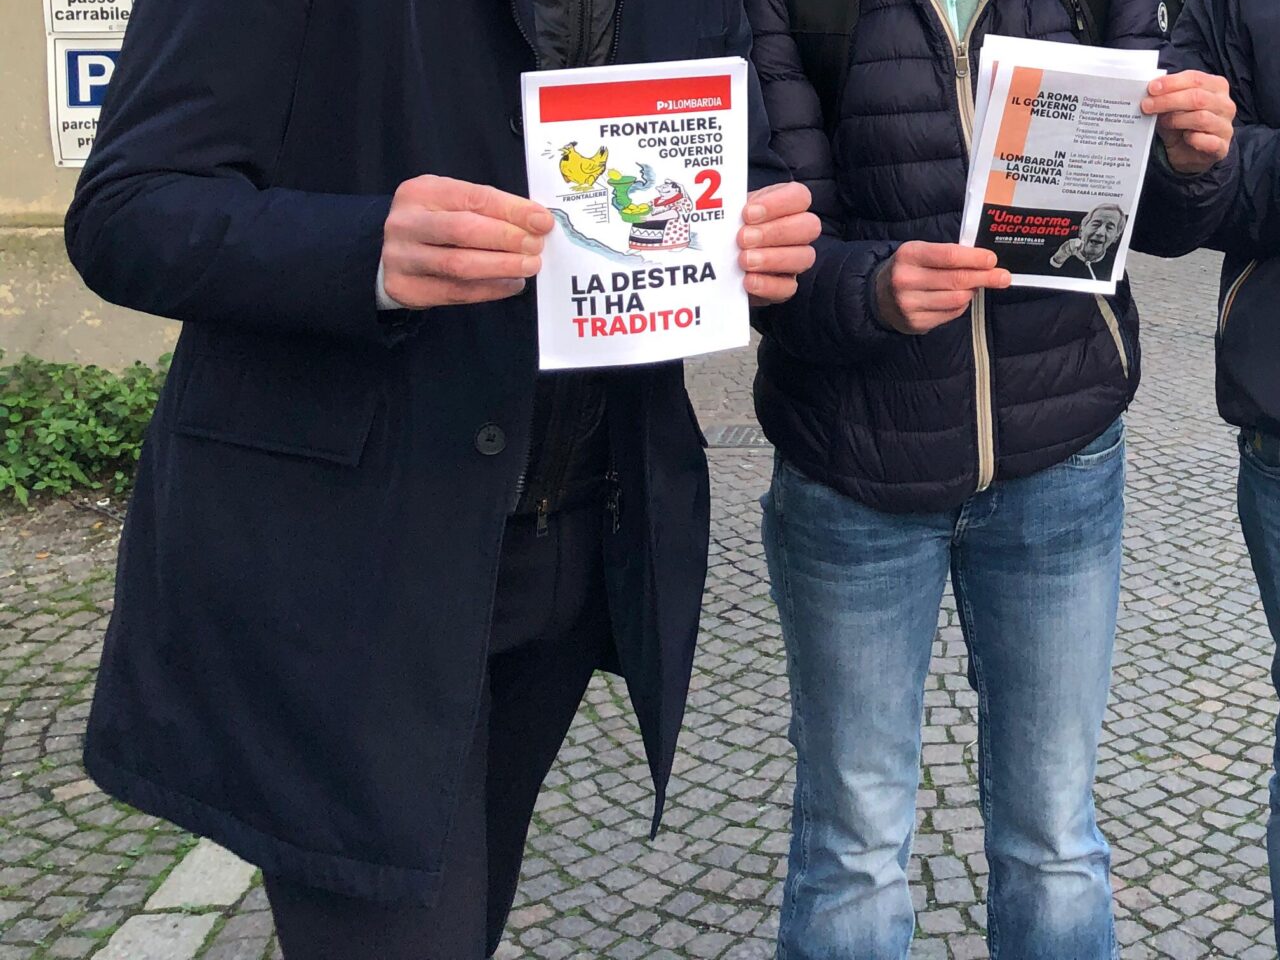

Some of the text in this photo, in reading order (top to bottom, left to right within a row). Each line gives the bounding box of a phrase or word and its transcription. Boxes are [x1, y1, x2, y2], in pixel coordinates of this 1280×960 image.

[55, 7, 130, 21] carrabile
[77, 55, 116, 102] P
[673, 97, 722, 110] LOMBARDIA
[1011, 96, 1077, 112] IL GOVERNO
[1037, 91, 1079, 104] A ROMA
[1030, 107, 1076, 121] MELONI:
[62, 118, 99, 132] parch
[600, 117, 722, 138] FRONTALIERE,
[637, 132, 723, 149] CON QUESTO
[659, 144, 723, 159] GOVERNO
[1054, 150, 1067, 160] IN
[684, 155, 724, 168] PAGHI
[1000, 152, 1065, 169] LOMBARDIA
[1006, 162, 1063, 177] LA GIUNTA
[1005, 171, 1060, 186] FONTANA:
[562, 190, 607, 202] FRONTALIERE
[694, 169, 723, 211] 2
[682, 209, 725, 223] VOLTE!
[1025, 215, 1071, 227] norma
[571, 261, 717, 295] LA DESTRA
[571, 292, 645, 317] TI HA
[572, 306, 701, 338] TRADITO!
